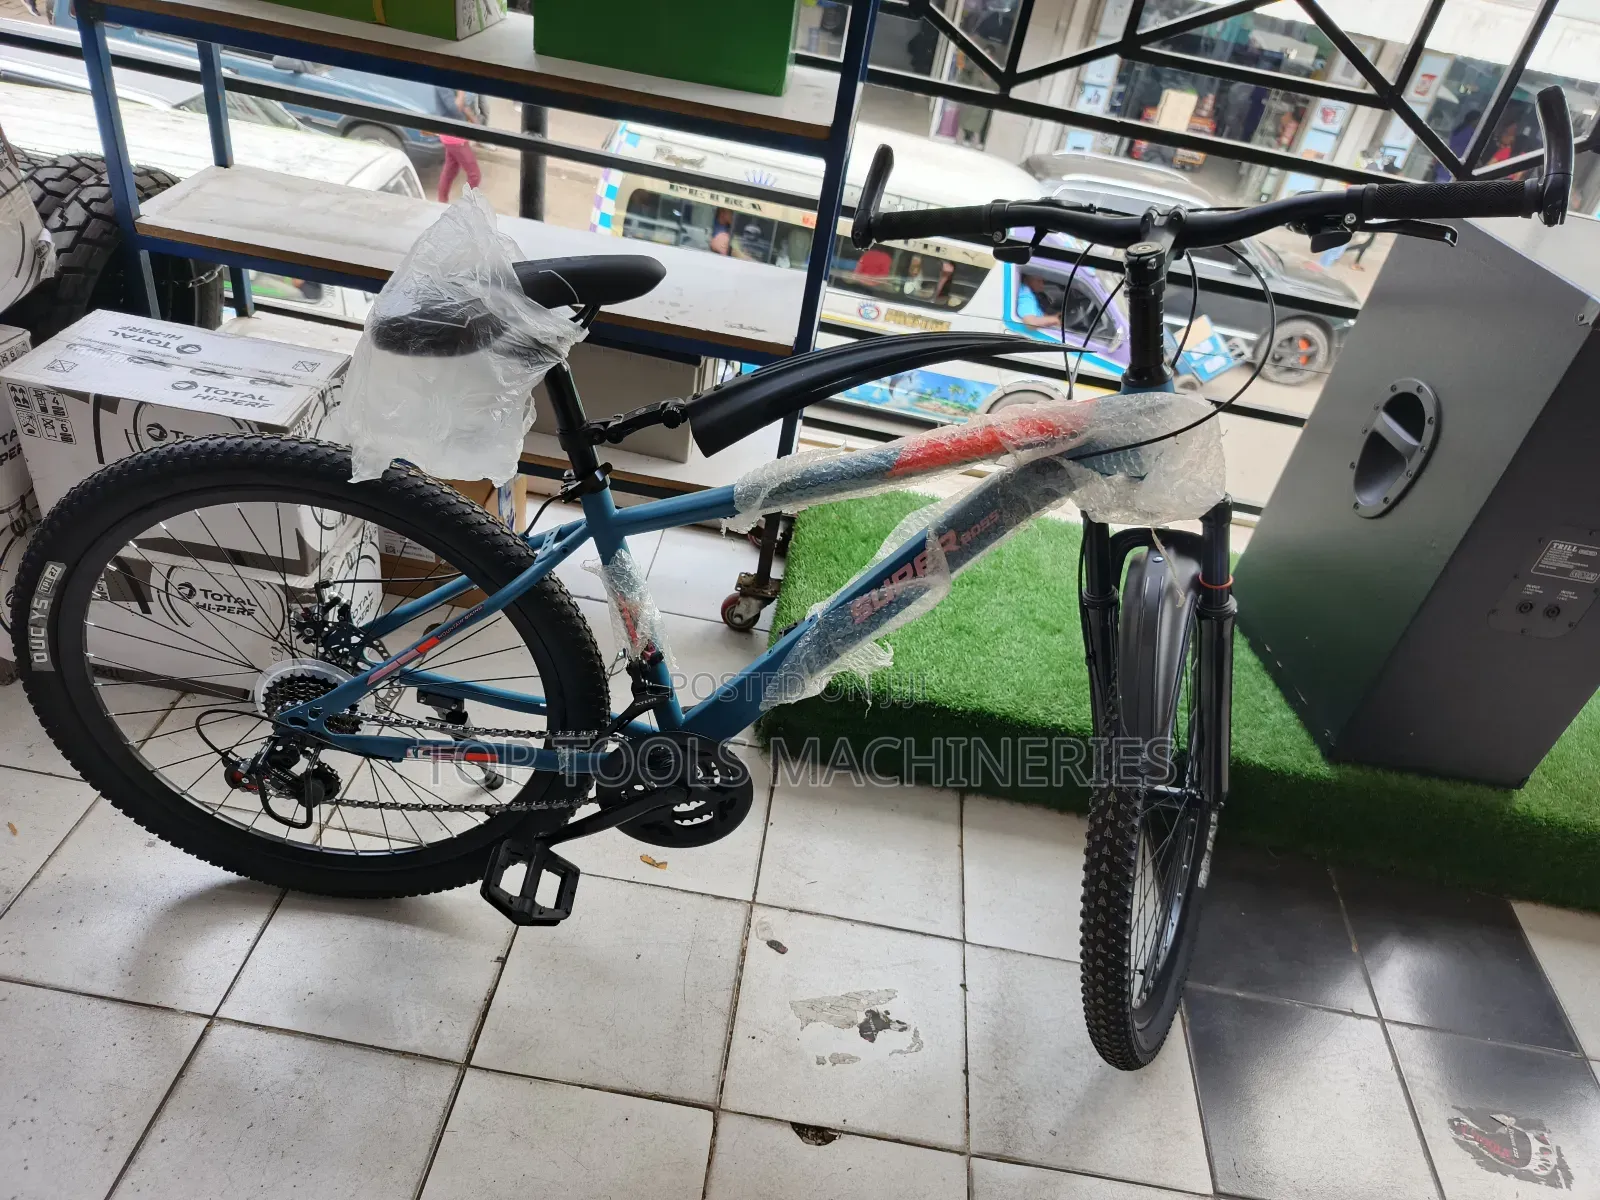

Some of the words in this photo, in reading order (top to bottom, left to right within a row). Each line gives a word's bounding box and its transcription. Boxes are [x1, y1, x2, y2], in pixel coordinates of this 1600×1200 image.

[108, 329, 172, 349] TOTAL
[52, 396, 60, 405] 4
[202, 385, 271, 402] TOTAL
[60, 423, 69, 433] 6
[1552, 542, 1578, 552] TRILL
[40, 576, 52, 591] TPI
[48, 566, 59, 577] 27
[198, 588, 258, 607] TOTAL
